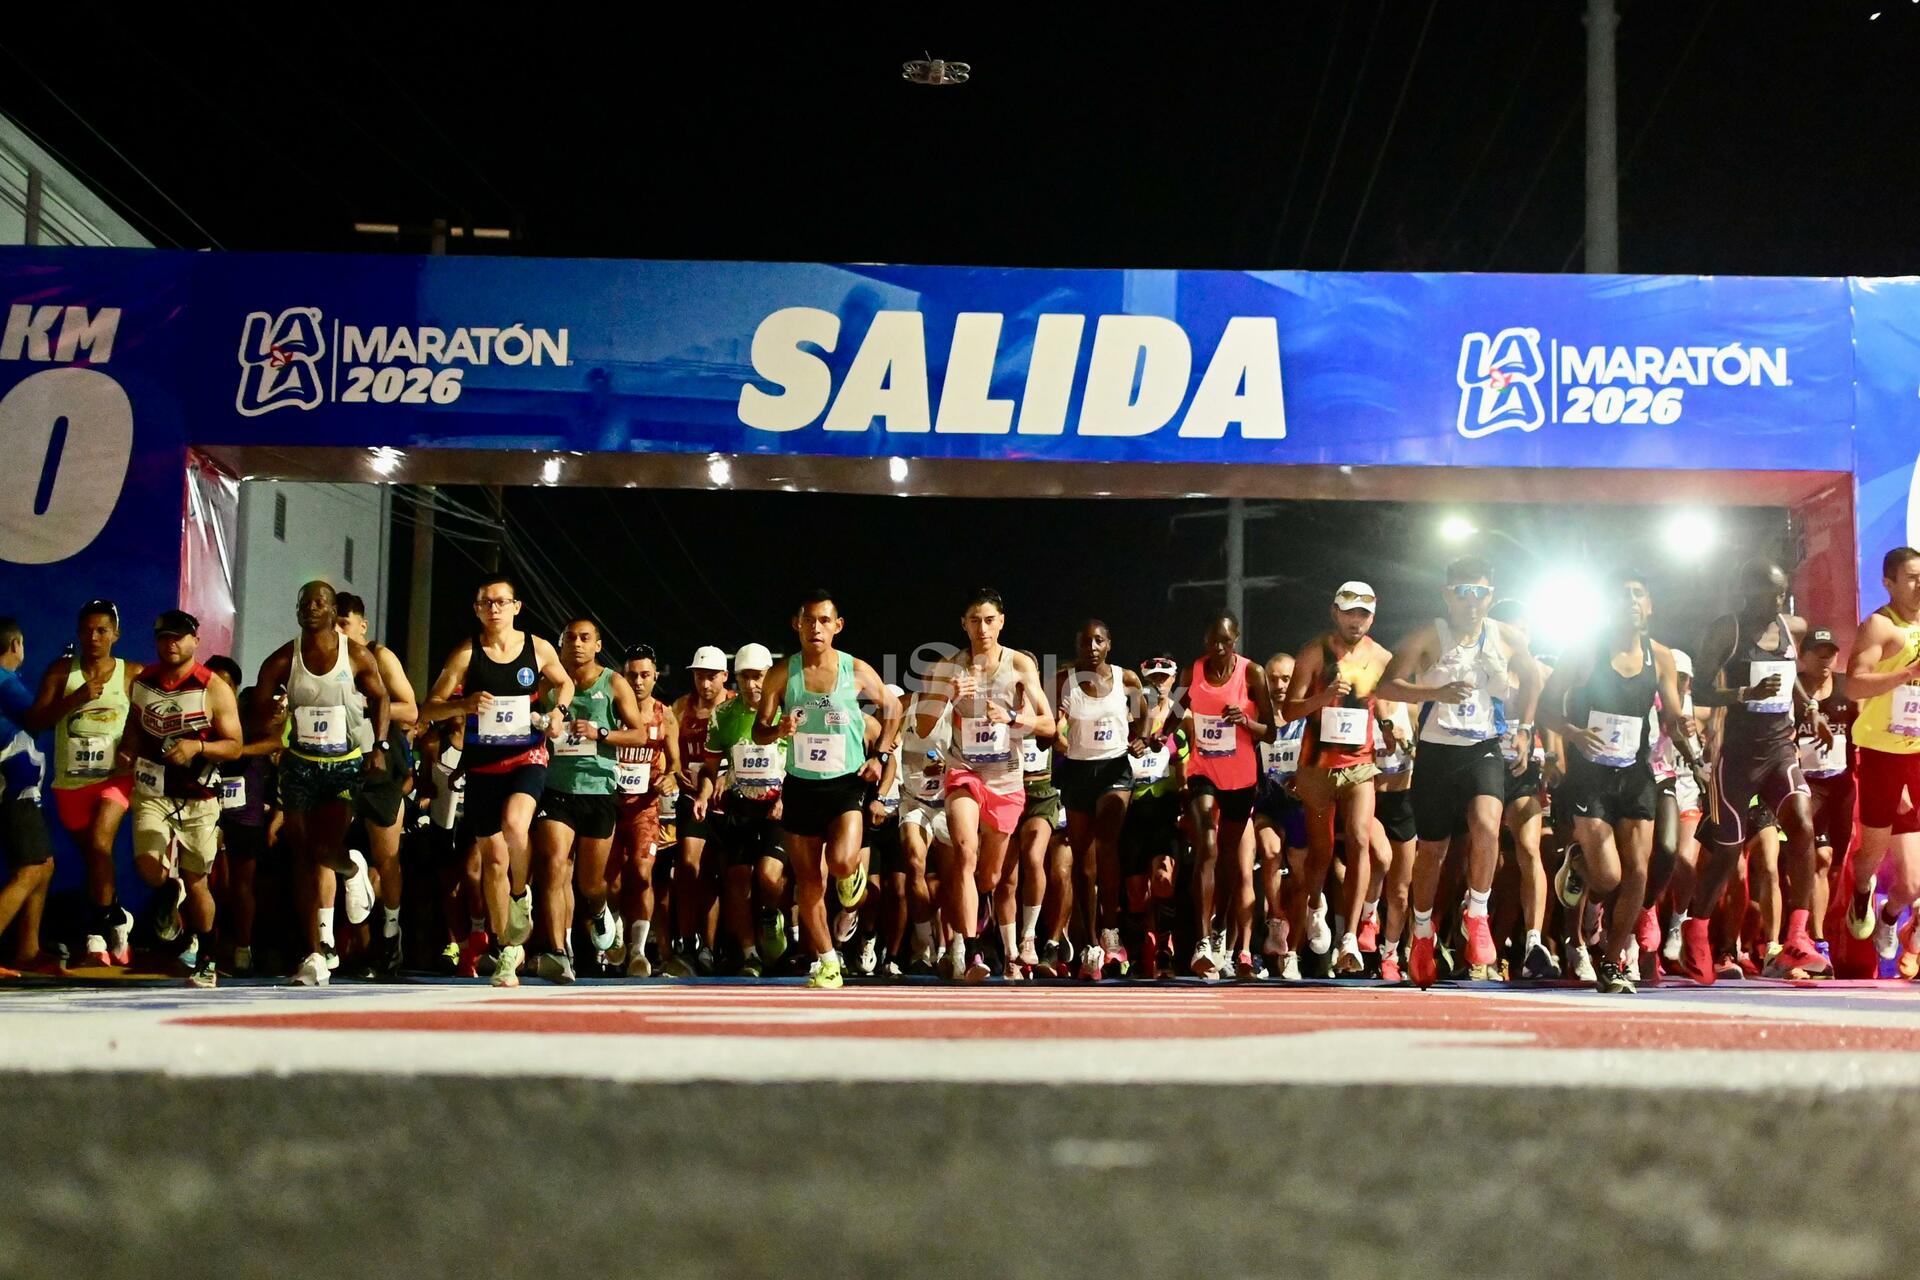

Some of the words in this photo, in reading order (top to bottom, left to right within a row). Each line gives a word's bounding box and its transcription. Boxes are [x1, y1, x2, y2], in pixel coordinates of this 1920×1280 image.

[1, 304, 121, 363] KM
[342, 322, 569, 367] MARATÓN
[1561, 342, 1786, 387] MARATÓN
[737, 306, 1287, 439] SALIDA
[342, 367, 463, 404] 2026
[1562, 386, 1683, 424] 2026
[1457, 704, 1476, 716] 59
[1903, 701, 1920, 714] 13
[495, 711, 514, 723] 56
[313, 721, 328, 732] 10
[1340, 722, 1353, 733] 12
[976, 731, 997, 743] 104
[1202, 729, 1222, 740] 103
[1610, 731, 1621, 743] 2
[75, 750, 104, 761] 3916
[810, 749, 827, 761] 52
[1268, 751, 1294, 763] 3601
[742, 757, 769, 768] 1983
